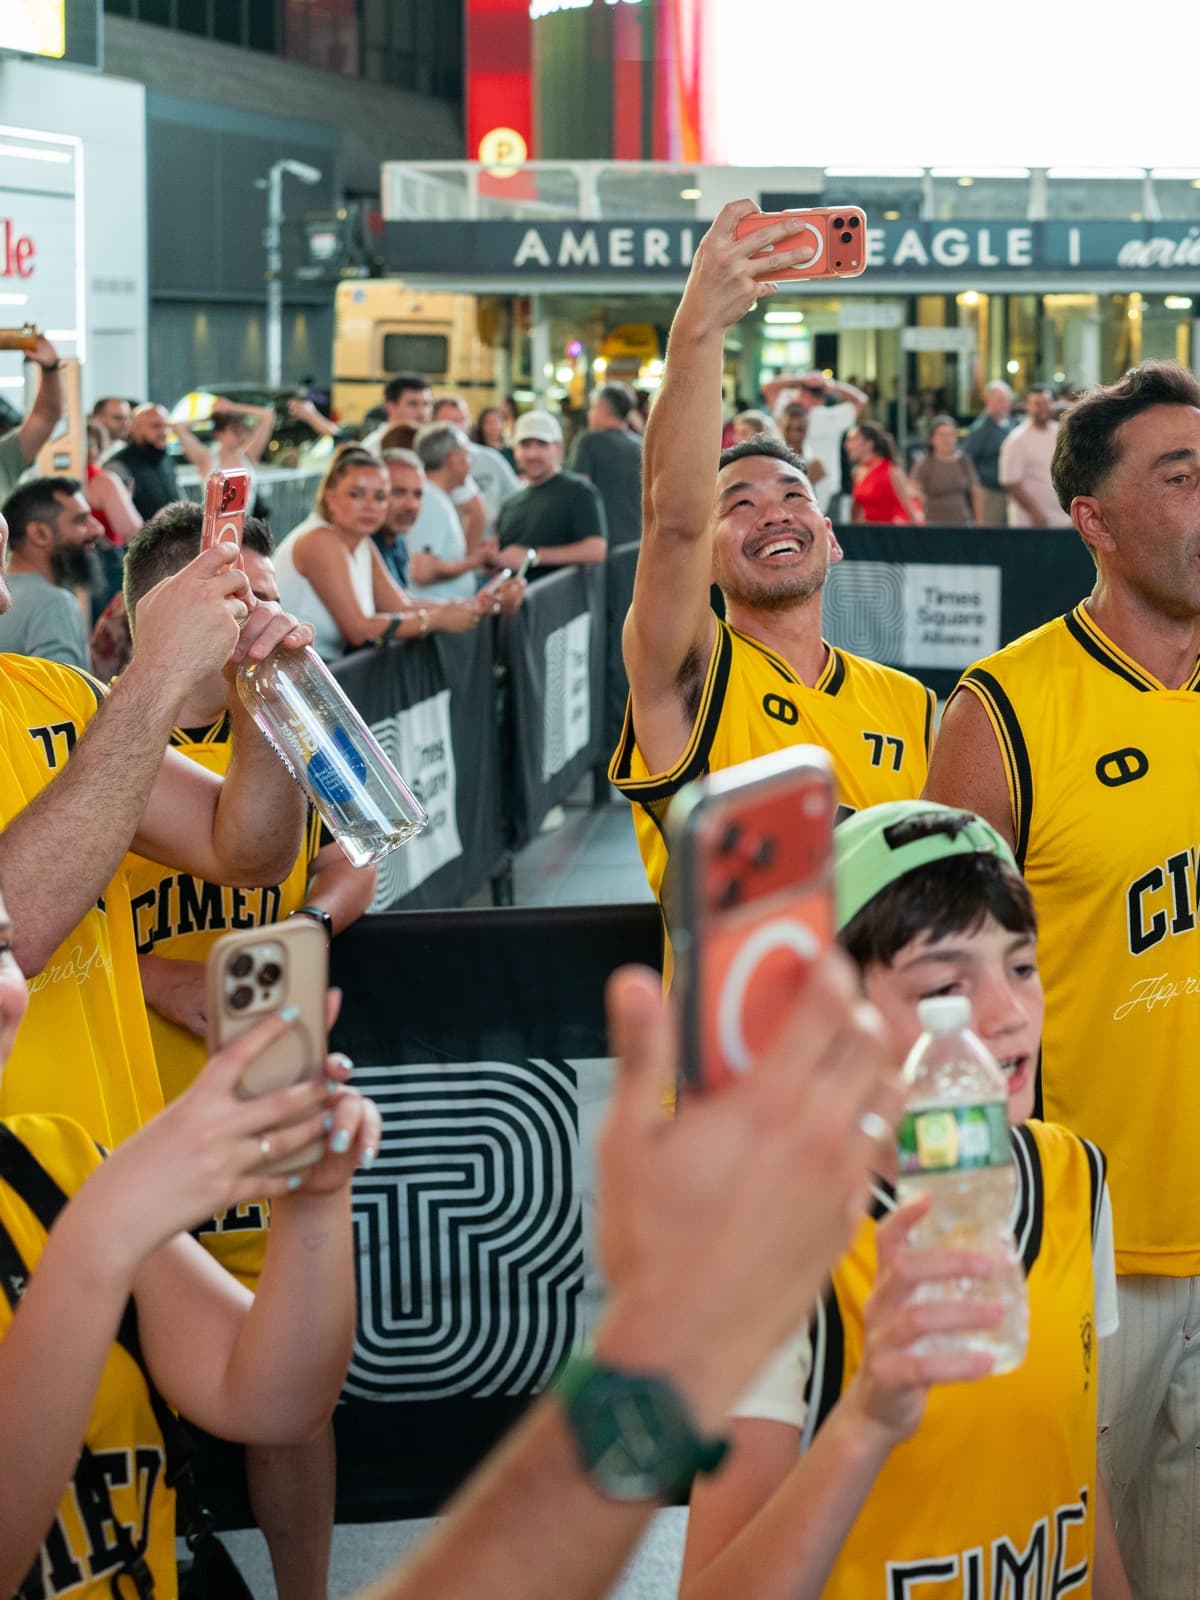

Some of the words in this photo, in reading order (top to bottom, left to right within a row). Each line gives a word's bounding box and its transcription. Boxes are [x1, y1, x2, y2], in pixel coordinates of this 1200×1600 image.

[513, 229, 700, 267] AMERI
[866, 228, 1033, 267] EAGLE
[925, 586, 982, 606] Times
[862, 730, 905, 773] 77
